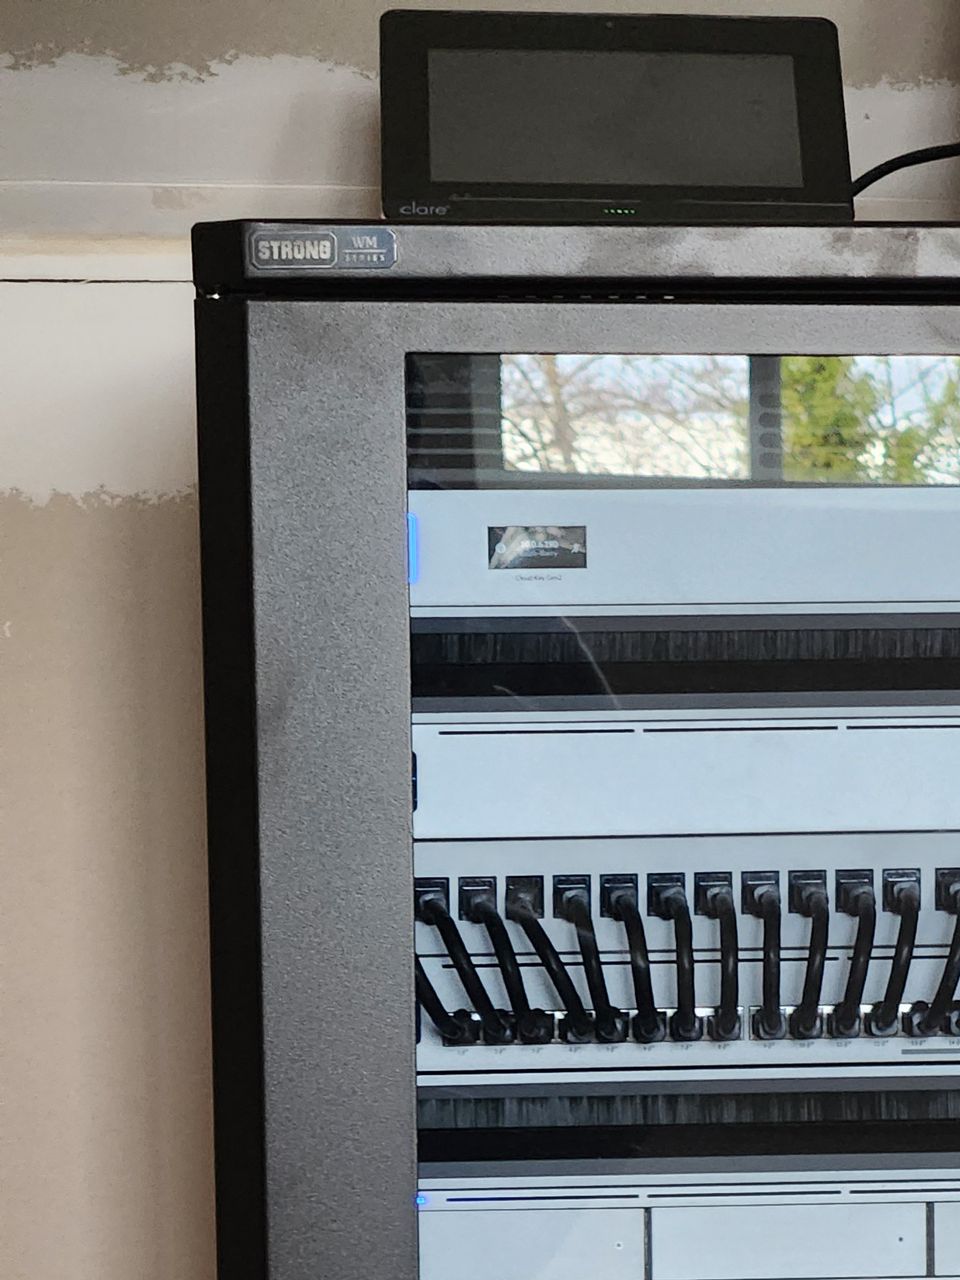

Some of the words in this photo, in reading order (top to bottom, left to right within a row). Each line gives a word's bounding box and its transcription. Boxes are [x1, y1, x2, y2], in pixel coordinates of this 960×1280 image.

[399, 201, 447, 216] clare
[351, 235, 378, 249] WM
[257, 240, 331, 260] STRONG
